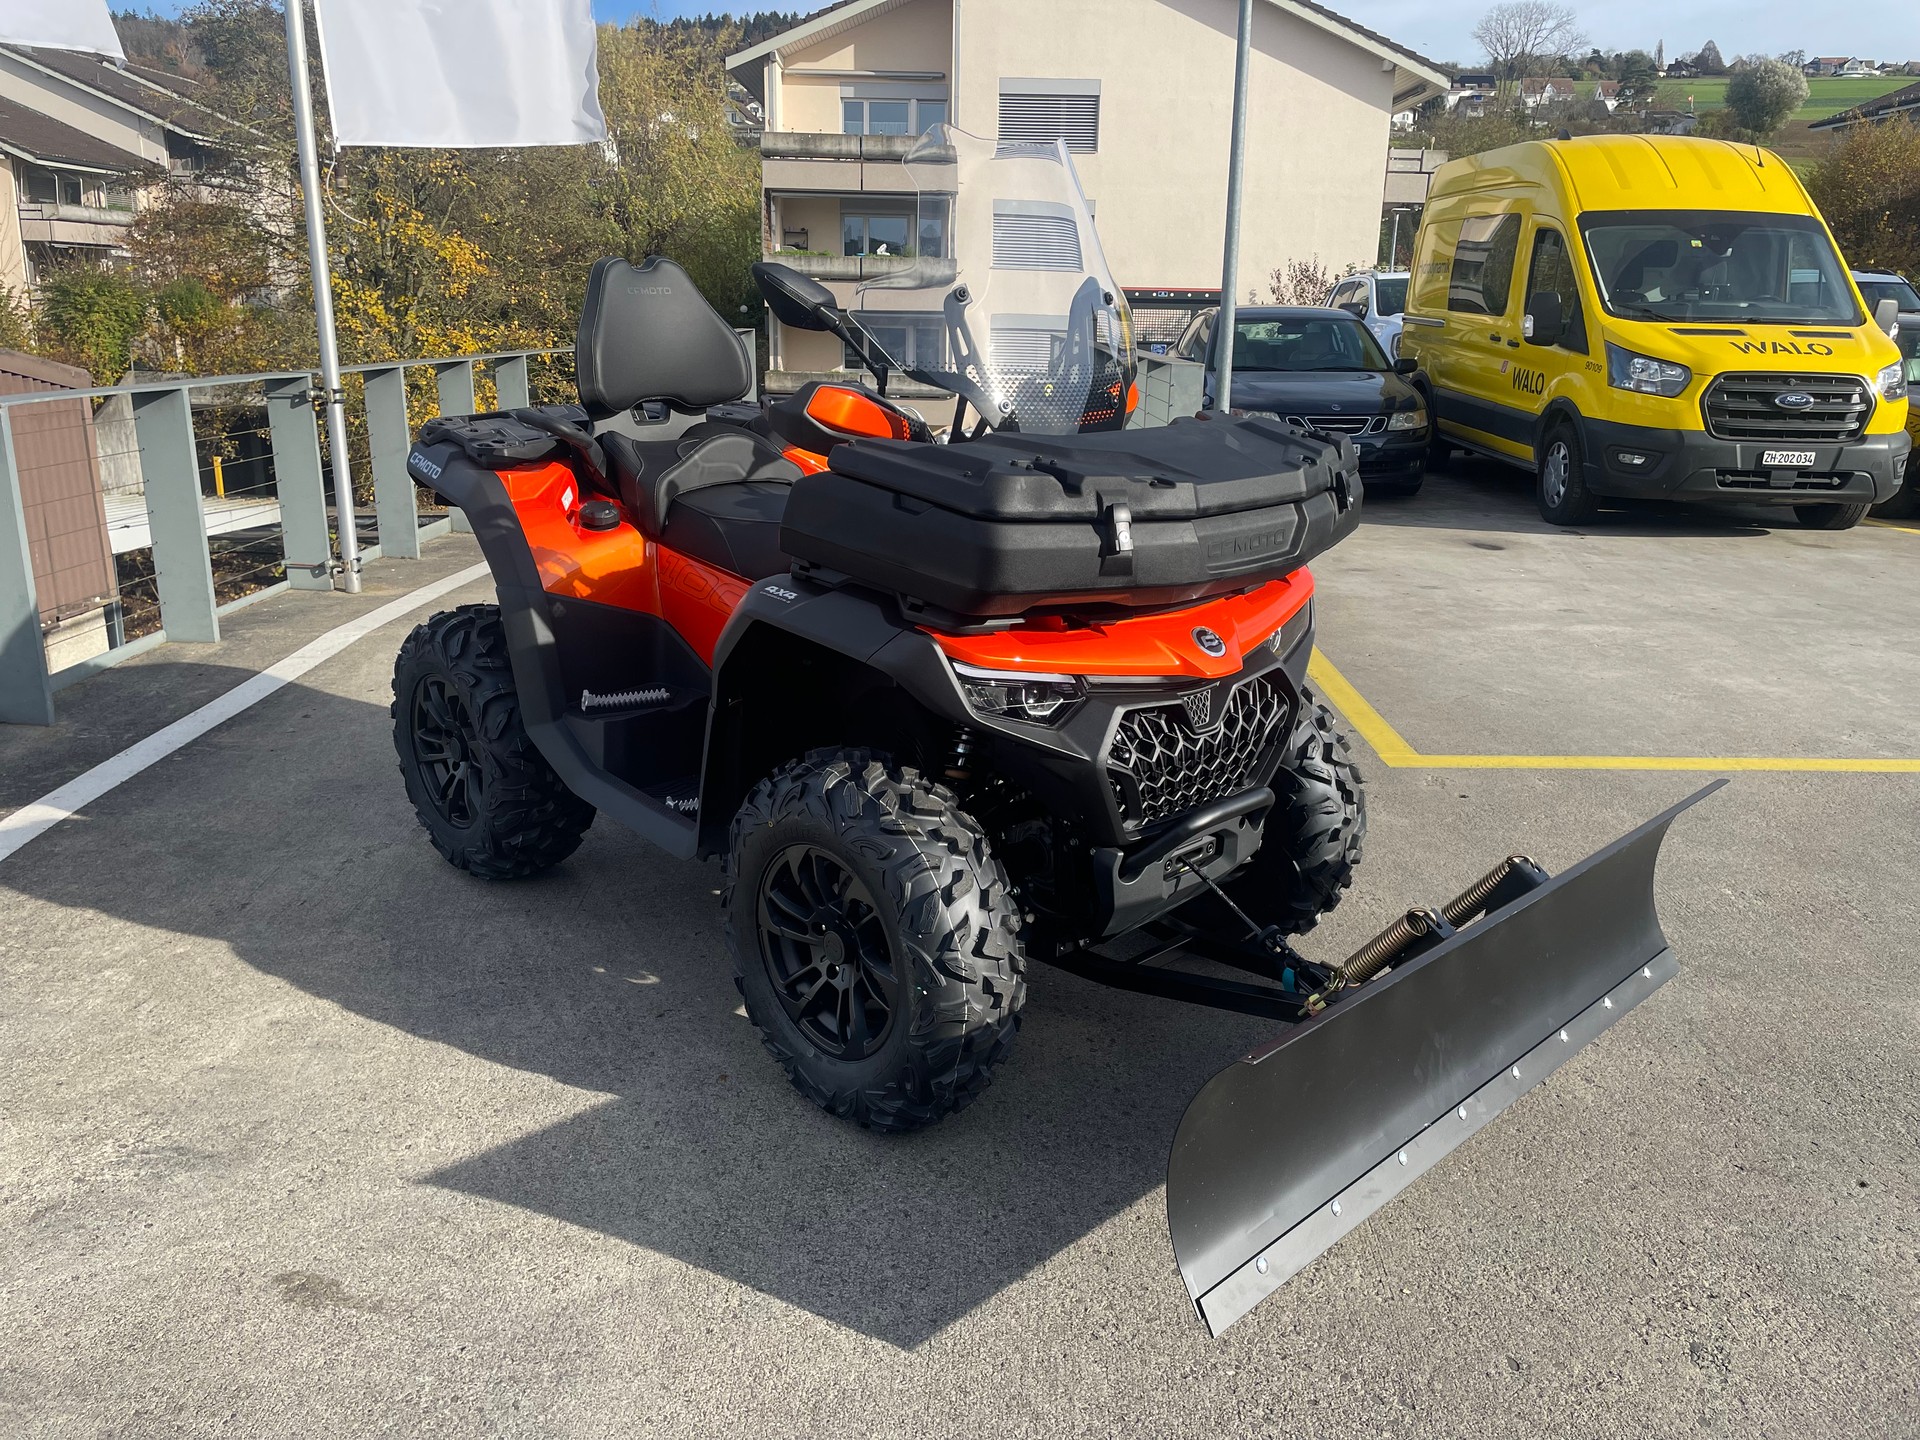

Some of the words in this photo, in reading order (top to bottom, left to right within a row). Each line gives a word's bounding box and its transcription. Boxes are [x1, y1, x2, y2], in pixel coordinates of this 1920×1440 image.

[627, 287, 672, 295] CFMOTO
[1729, 341, 1833, 356] WALO
[1585, 361, 1603, 373] 90109
[1512, 367, 1545, 395] WALO
[410, 452, 442, 479] CFMOTO
